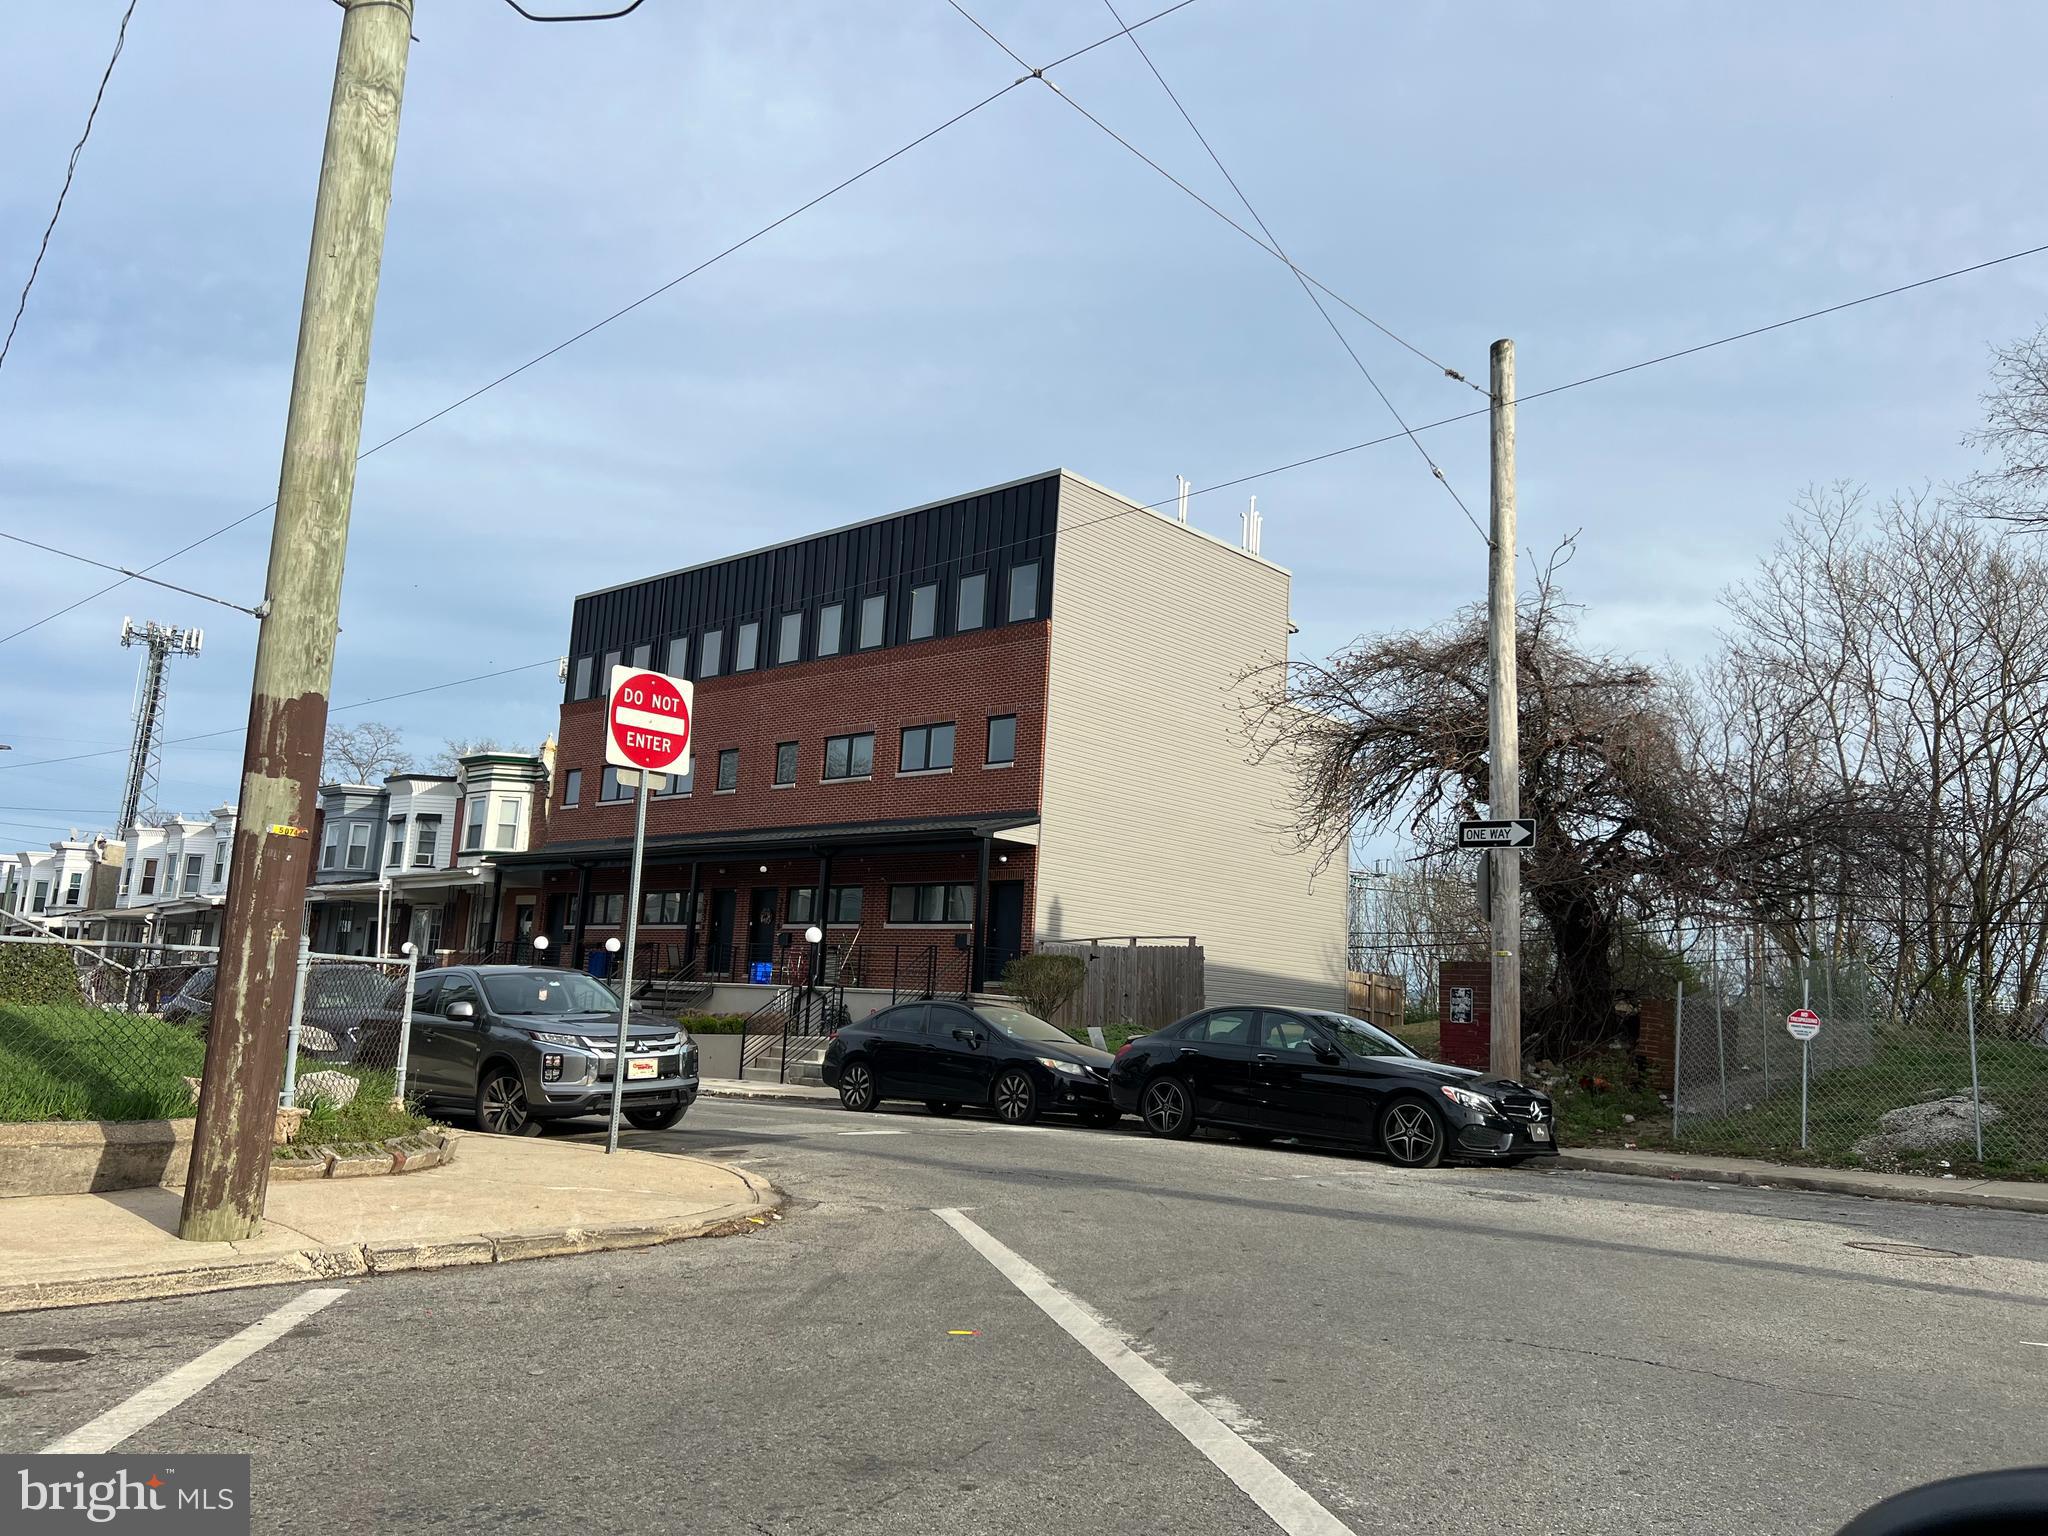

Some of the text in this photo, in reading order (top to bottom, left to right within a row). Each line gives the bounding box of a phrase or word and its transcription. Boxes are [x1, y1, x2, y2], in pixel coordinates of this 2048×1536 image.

[623, 687, 680, 712] DO NOT
[626, 731, 671, 753] ENTER
[1466, 828, 1512, 840] ONE WAY
